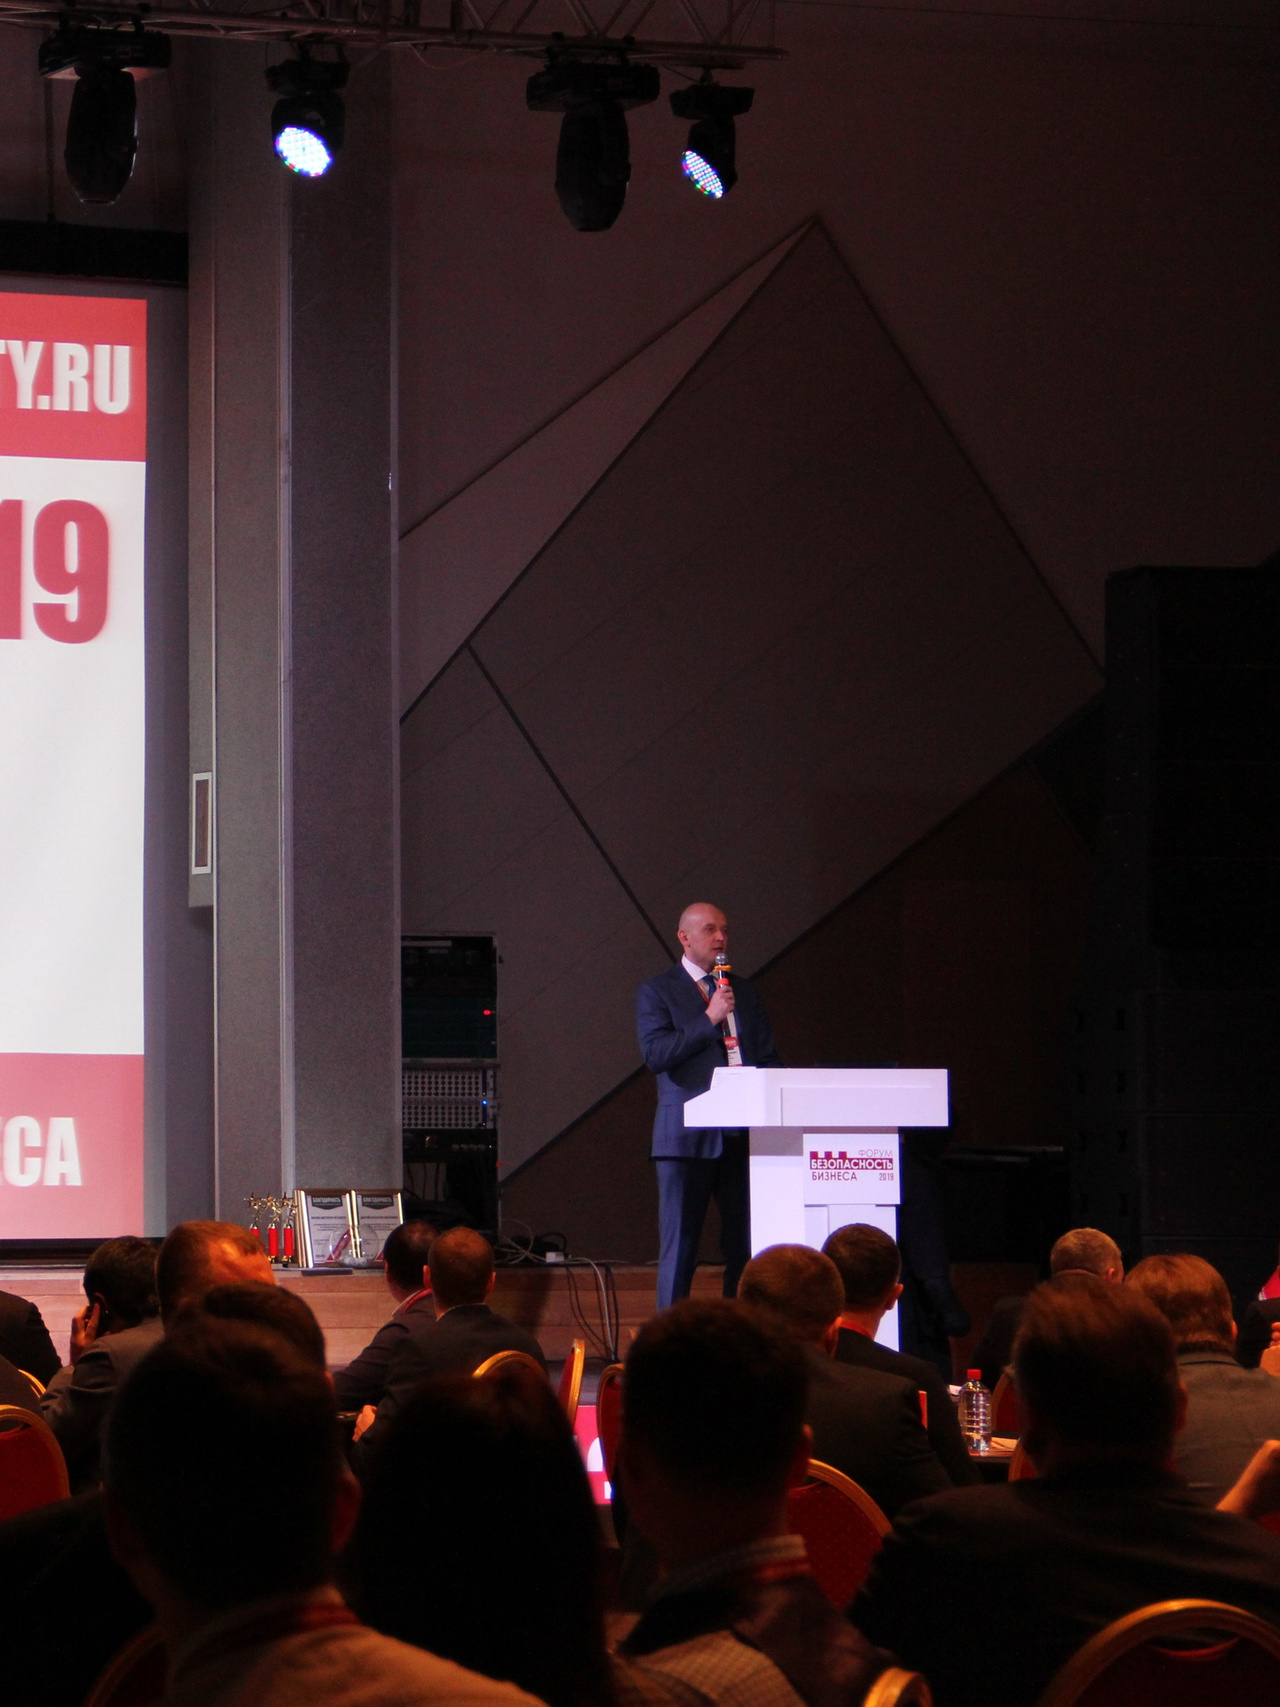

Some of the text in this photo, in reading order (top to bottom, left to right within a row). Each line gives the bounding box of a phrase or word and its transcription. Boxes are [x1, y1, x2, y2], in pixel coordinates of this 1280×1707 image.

[858, 1149, 893, 1158] ФОРУМ
[811, 1159, 893, 1169] БЕЗОПАСНОСТЬ
[811, 1171, 894, 1181] БИЗНЕСА 2019
